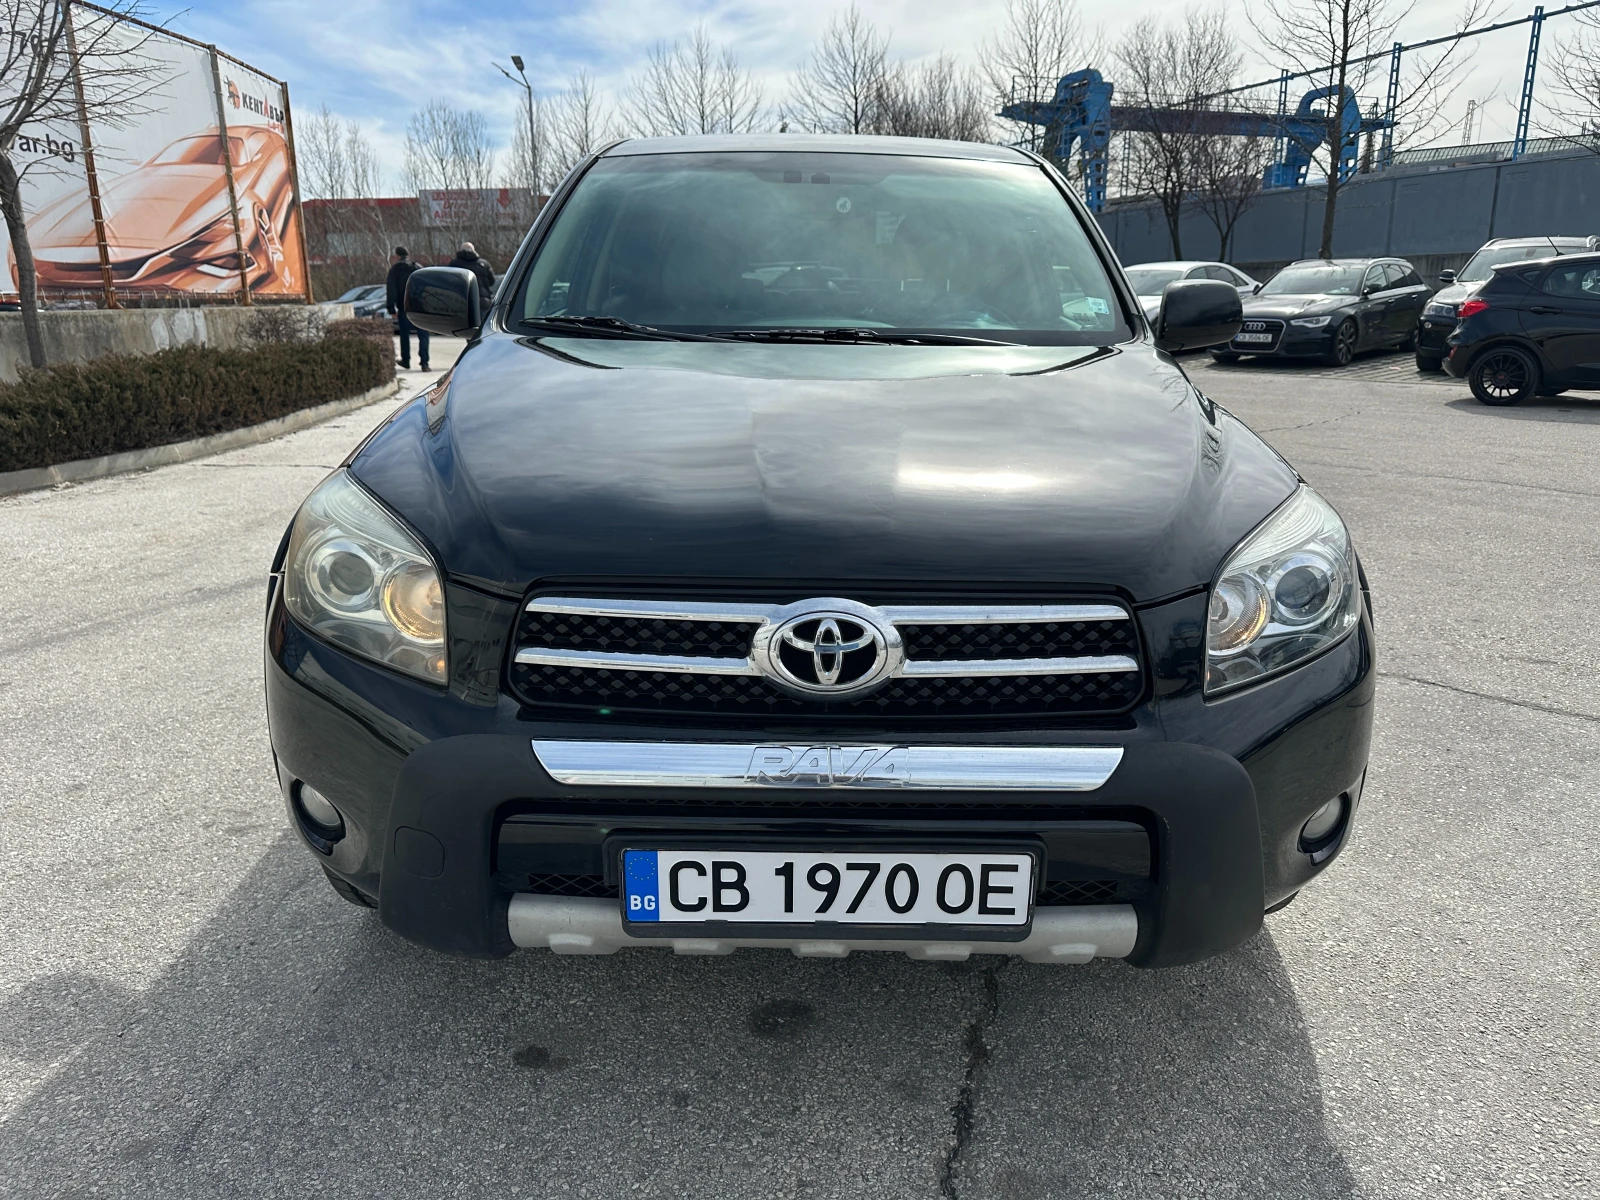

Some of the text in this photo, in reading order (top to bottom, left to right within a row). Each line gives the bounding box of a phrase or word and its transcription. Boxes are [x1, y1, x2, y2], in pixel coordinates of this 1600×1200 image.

[744, 746, 912, 788] RAV4
[630, 895, 656, 911] BG
[669, 860, 1020, 916] CB 1970 OE
